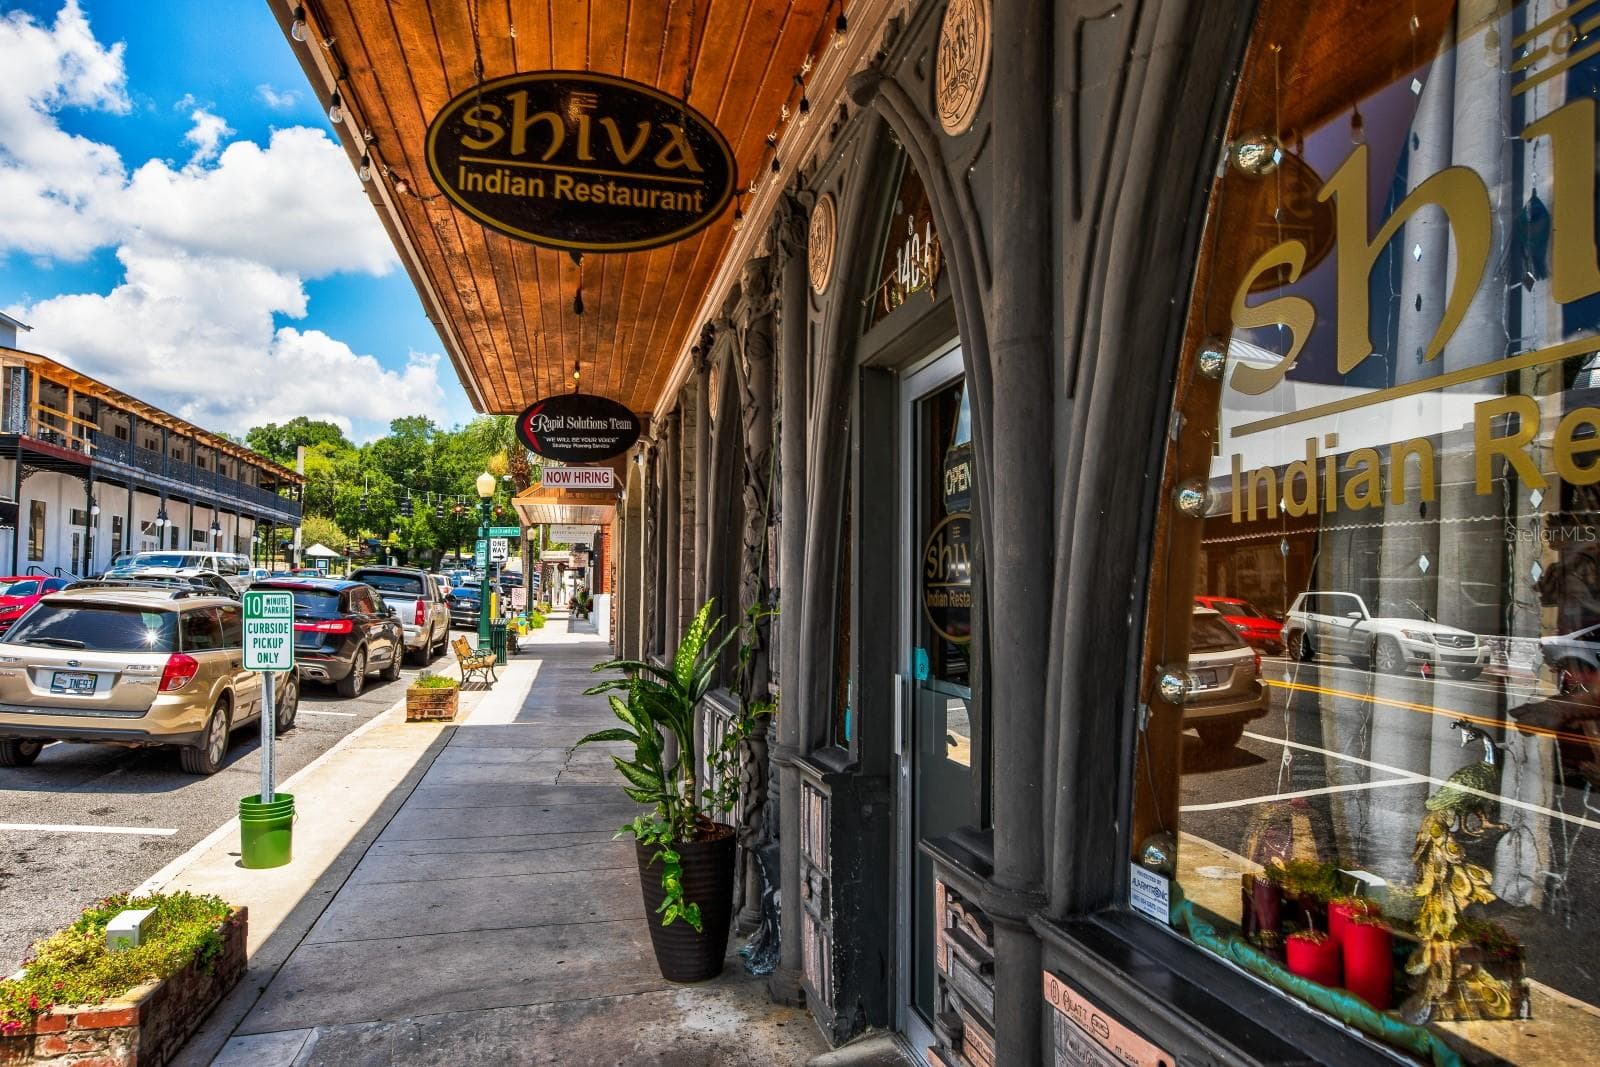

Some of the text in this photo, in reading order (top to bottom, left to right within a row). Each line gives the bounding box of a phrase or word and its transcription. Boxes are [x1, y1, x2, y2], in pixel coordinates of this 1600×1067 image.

[459, 165, 703, 212] Indian Restaurant
[530, 413, 632, 433] Rapid Solutions Team
[546, 471, 610, 484] NOW HIRING
[1231, 433, 1434, 523] Indian
[245, 596, 288, 616] 10 MINUTE
[264, 606, 289, 614] PARKING
[248, 622, 289, 634] CURBSIDE
[253, 637, 284, 649] PICKUP
[257, 652, 279, 664] ONLY
